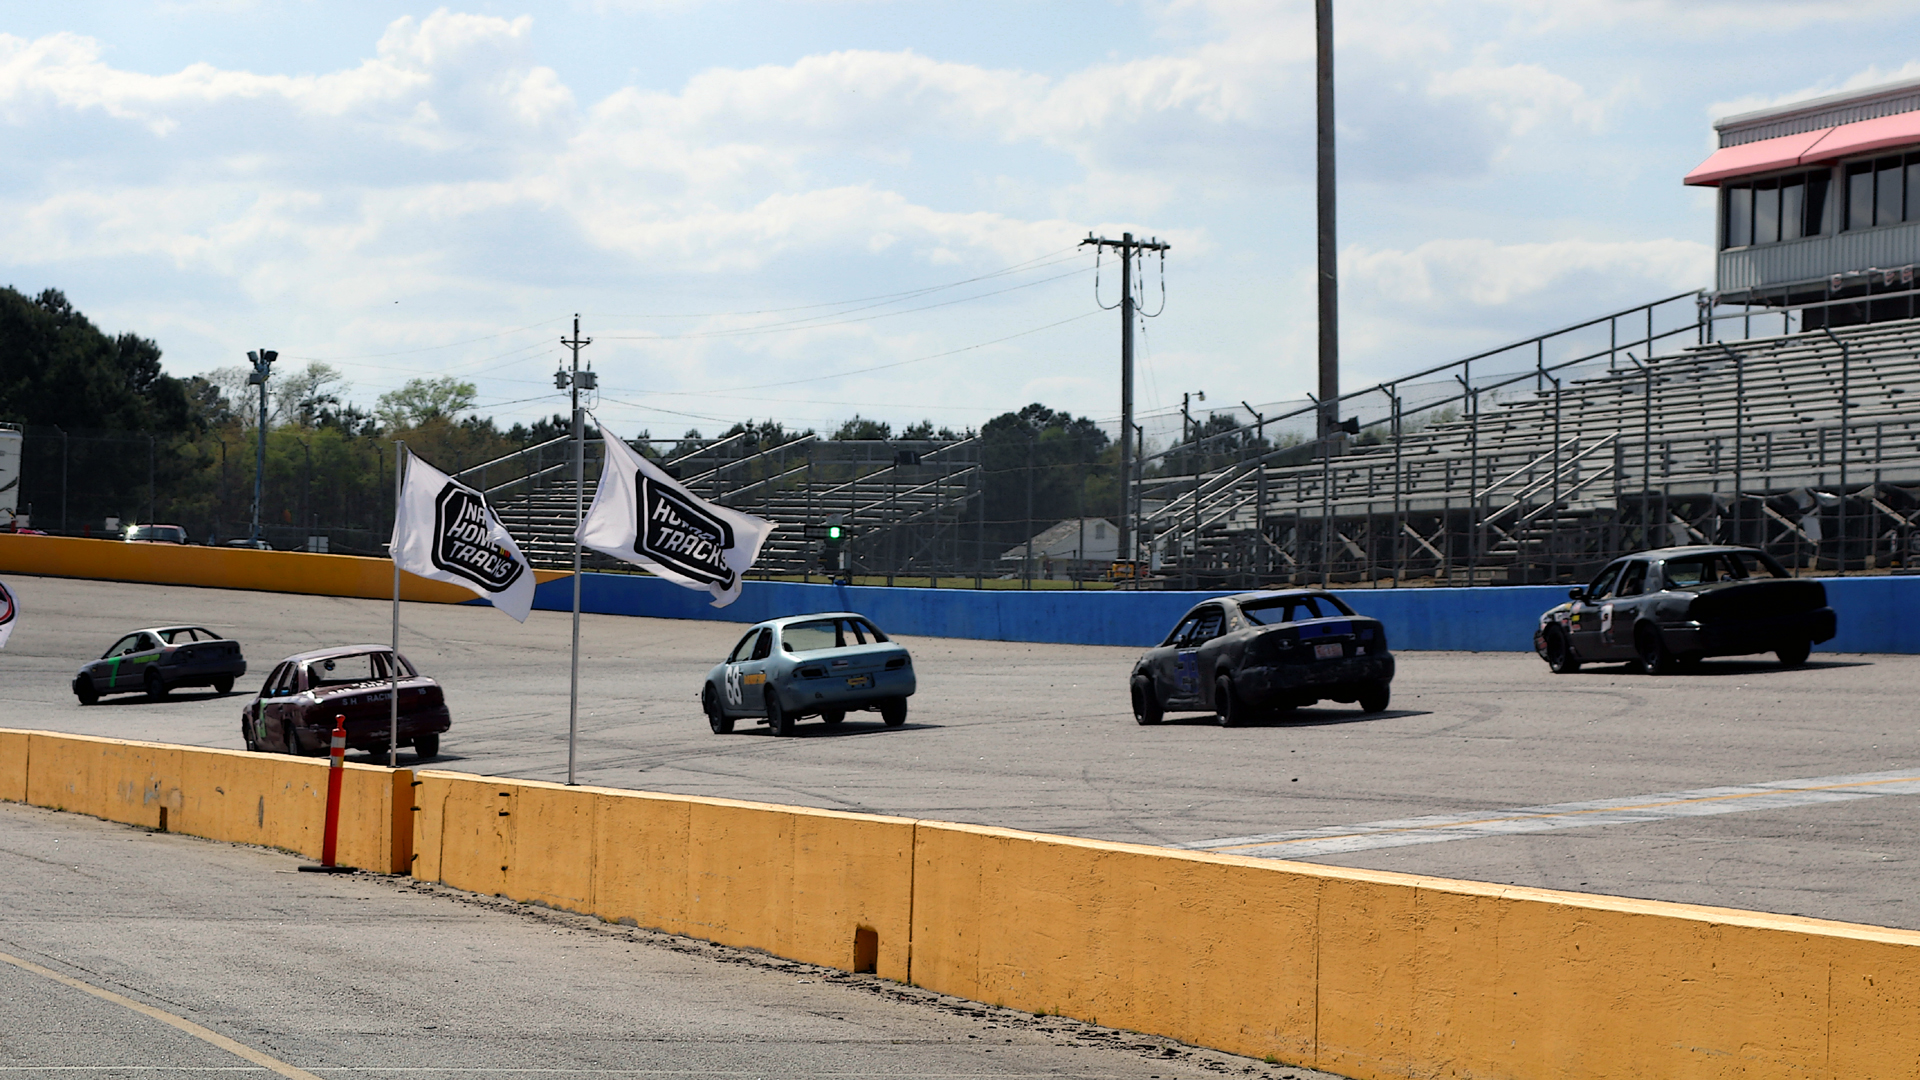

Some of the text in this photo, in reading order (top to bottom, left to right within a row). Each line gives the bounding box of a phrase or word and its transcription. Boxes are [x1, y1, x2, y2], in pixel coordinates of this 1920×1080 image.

[449, 541, 512, 578] TRACKS
[366, 691, 399, 703] RACIN
[725, 666, 742, 706] 68
